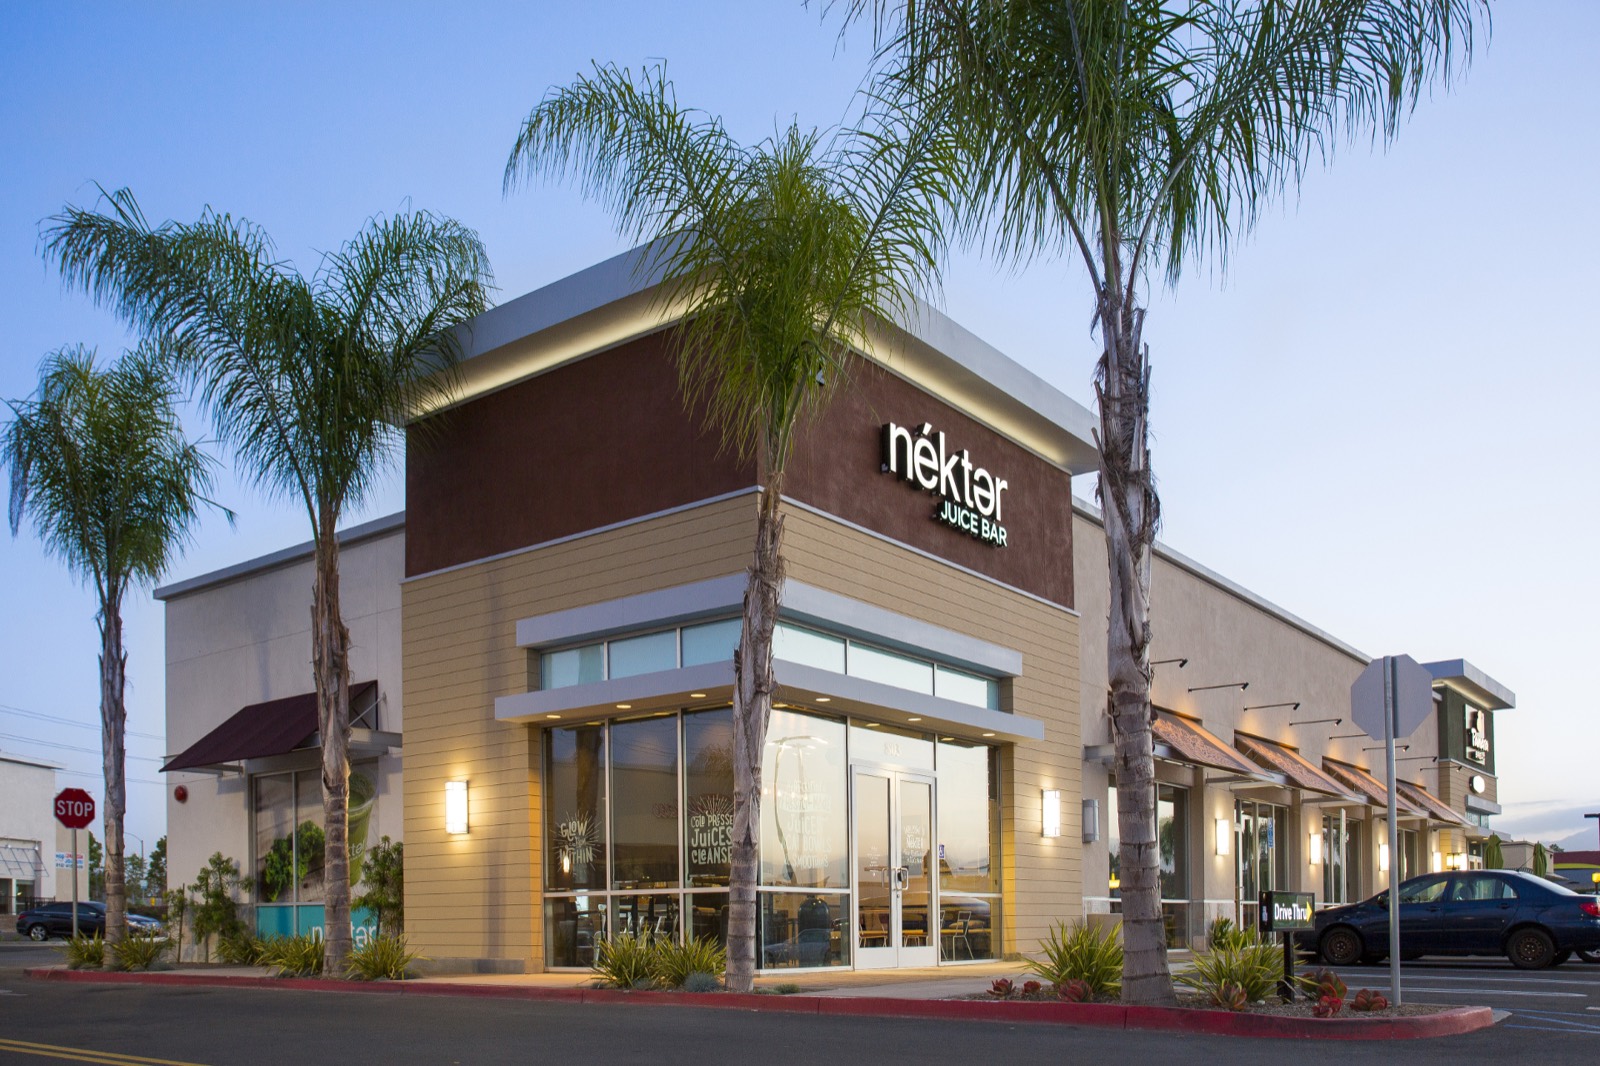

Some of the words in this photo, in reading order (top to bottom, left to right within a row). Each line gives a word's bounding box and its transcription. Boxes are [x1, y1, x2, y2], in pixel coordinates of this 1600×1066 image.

[940, 500, 979, 535] JUICE
[981, 518, 1008, 547] BAR
[56, 799, 93, 817] STOP
[706, 811, 734, 827] PRESSE
[560, 820, 588, 842] GLOW
[1274, 902, 1292, 920] Drive
[1292, 903, 1308, 920] Thru
